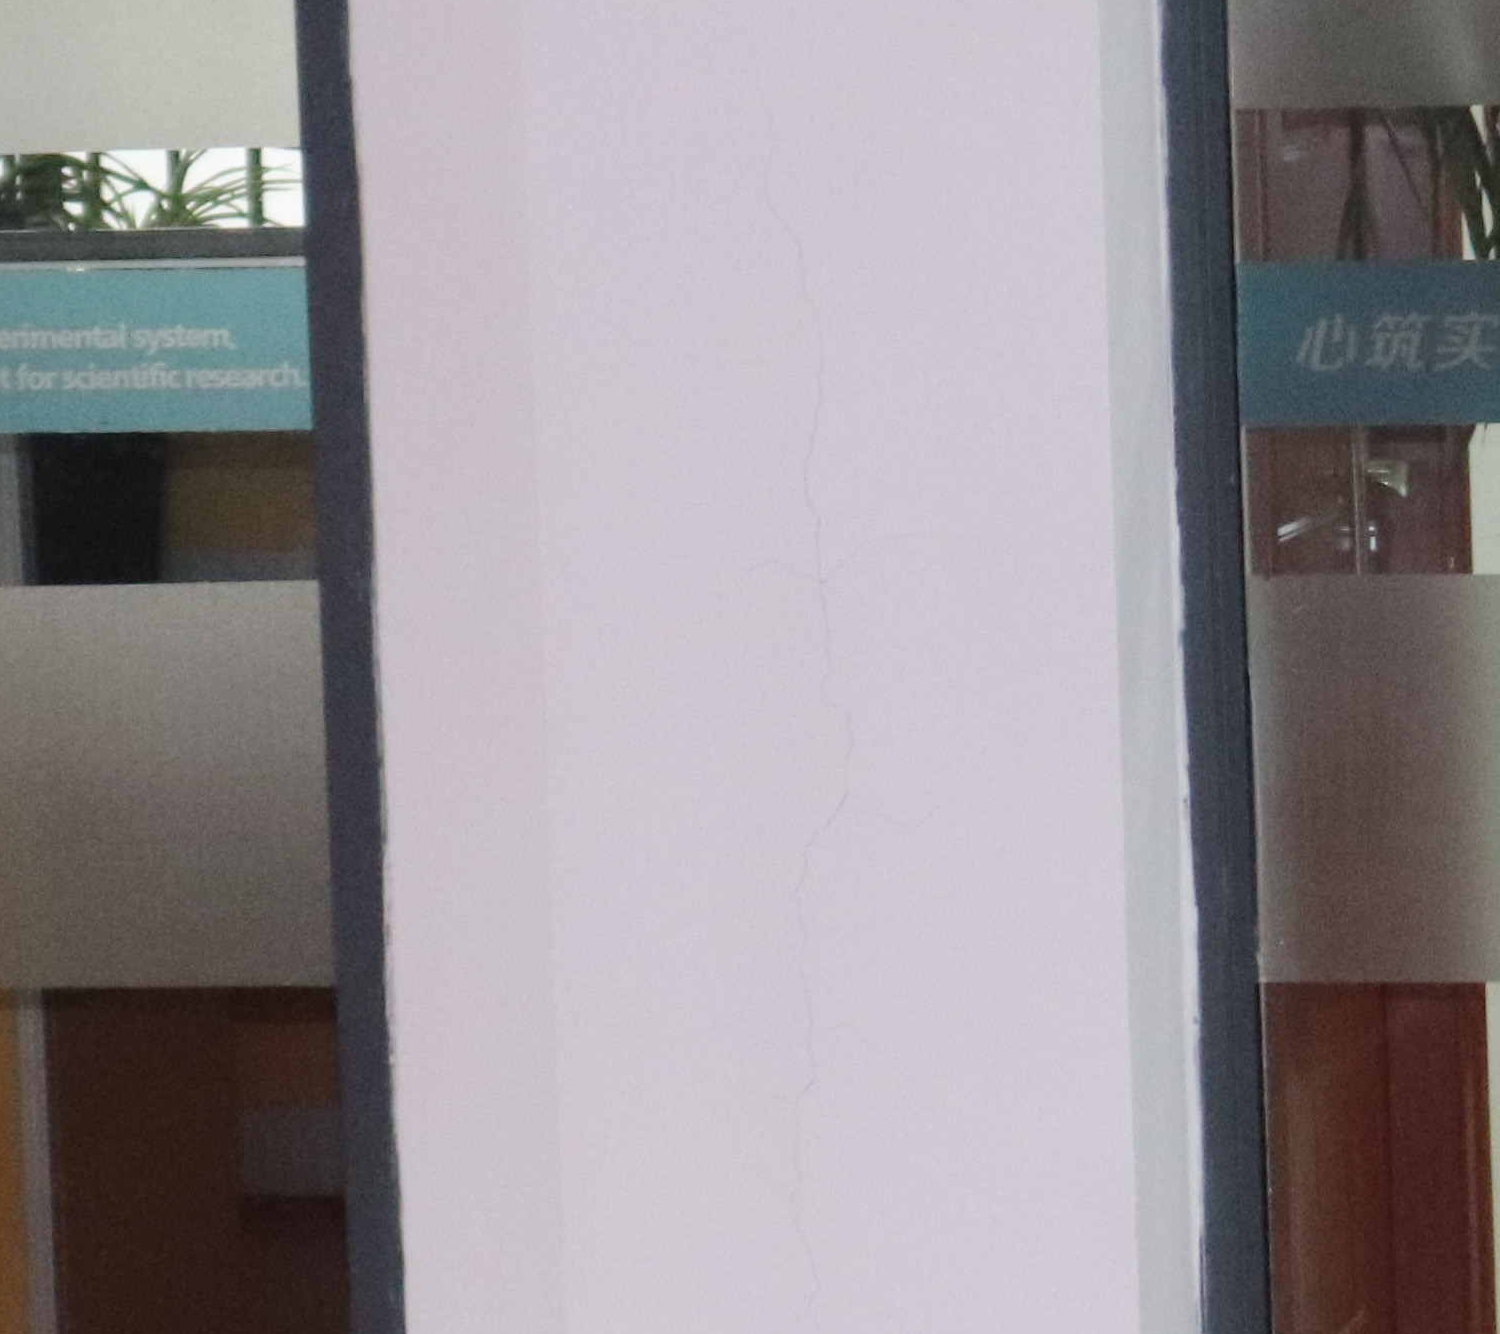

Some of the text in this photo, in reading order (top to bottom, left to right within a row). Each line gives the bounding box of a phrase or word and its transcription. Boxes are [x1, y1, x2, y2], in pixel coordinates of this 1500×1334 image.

[130, 322, 238, 356] system,
[15, 362, 56, 391] for
[61, 361, 182, 390] scientific
[185, 359, 308, 389] research.
